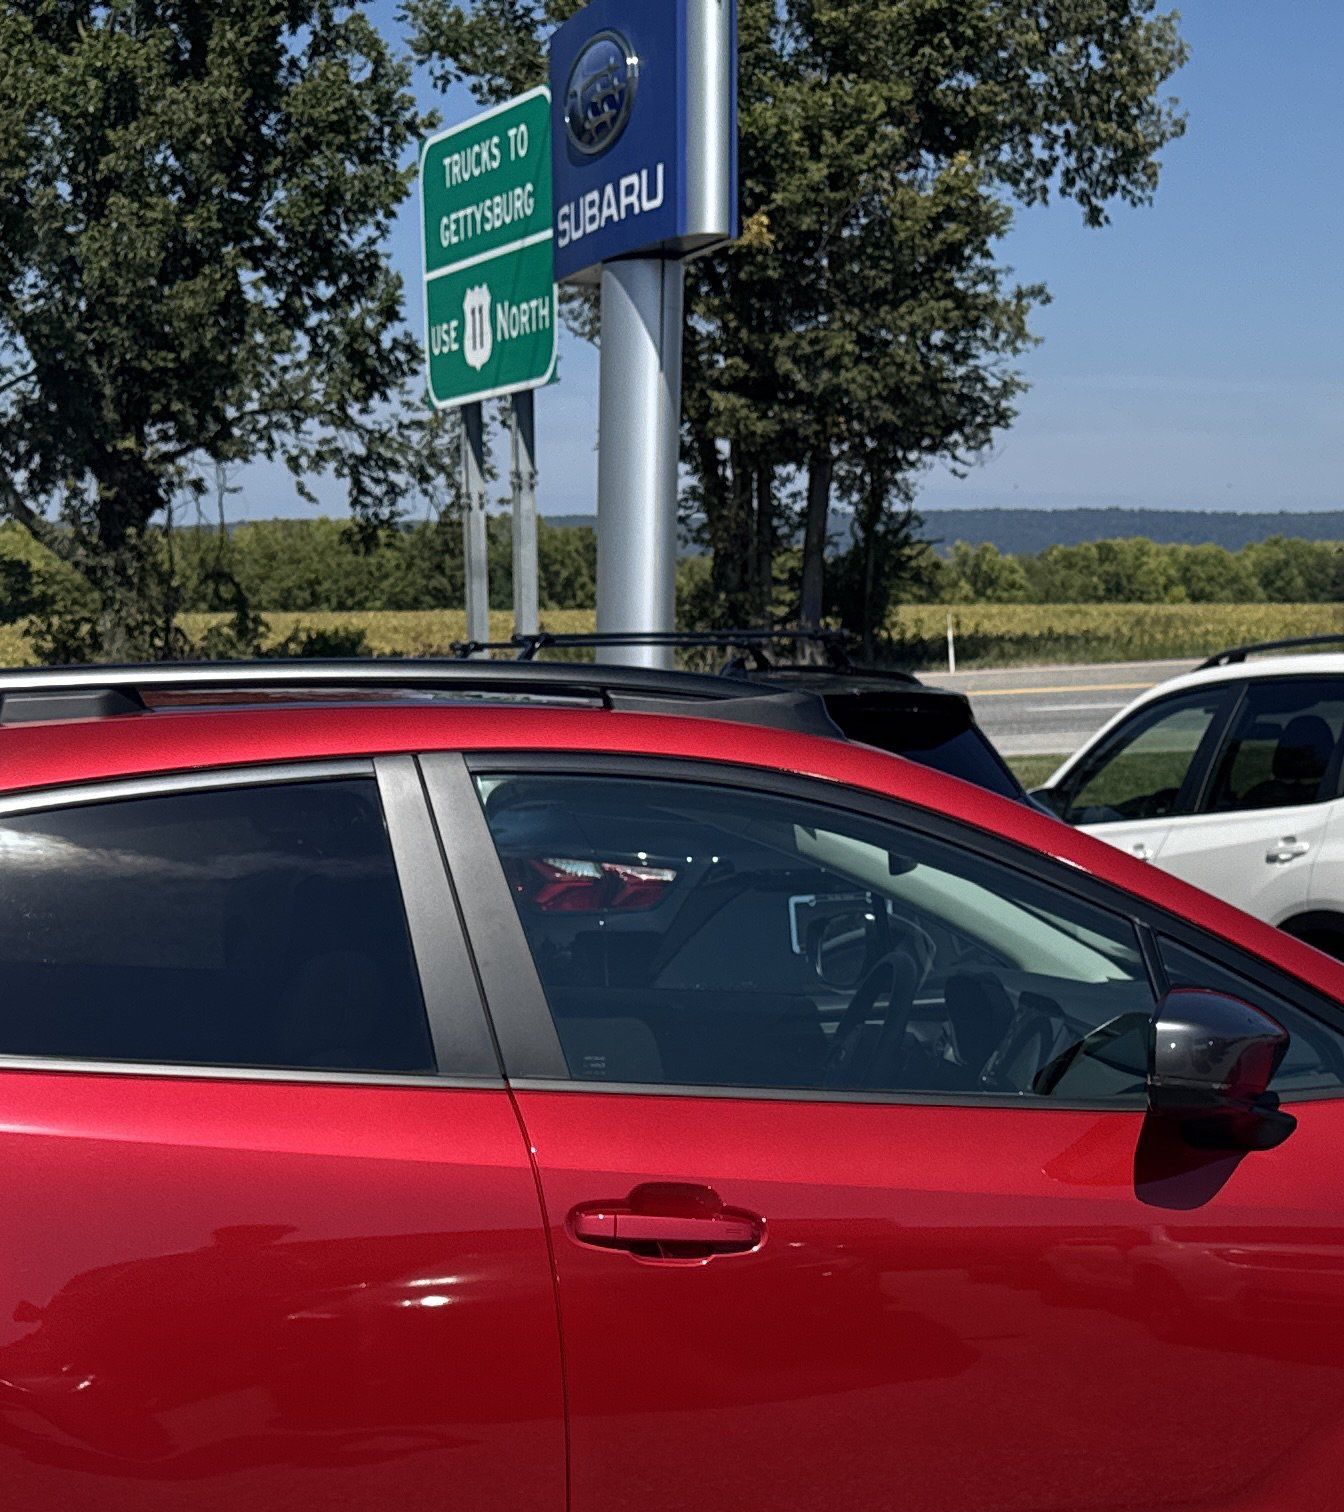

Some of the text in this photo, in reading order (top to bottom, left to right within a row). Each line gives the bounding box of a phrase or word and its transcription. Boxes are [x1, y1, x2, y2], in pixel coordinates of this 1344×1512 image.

[443, 122, 528, 188] TRUCKS TO
[440, 182, 535, 248] GETTYSBURG
[557, 162, 664, 248] SUBARU
[431, 319, 459, 356] USE
[471, 304, 484, 351] 11
